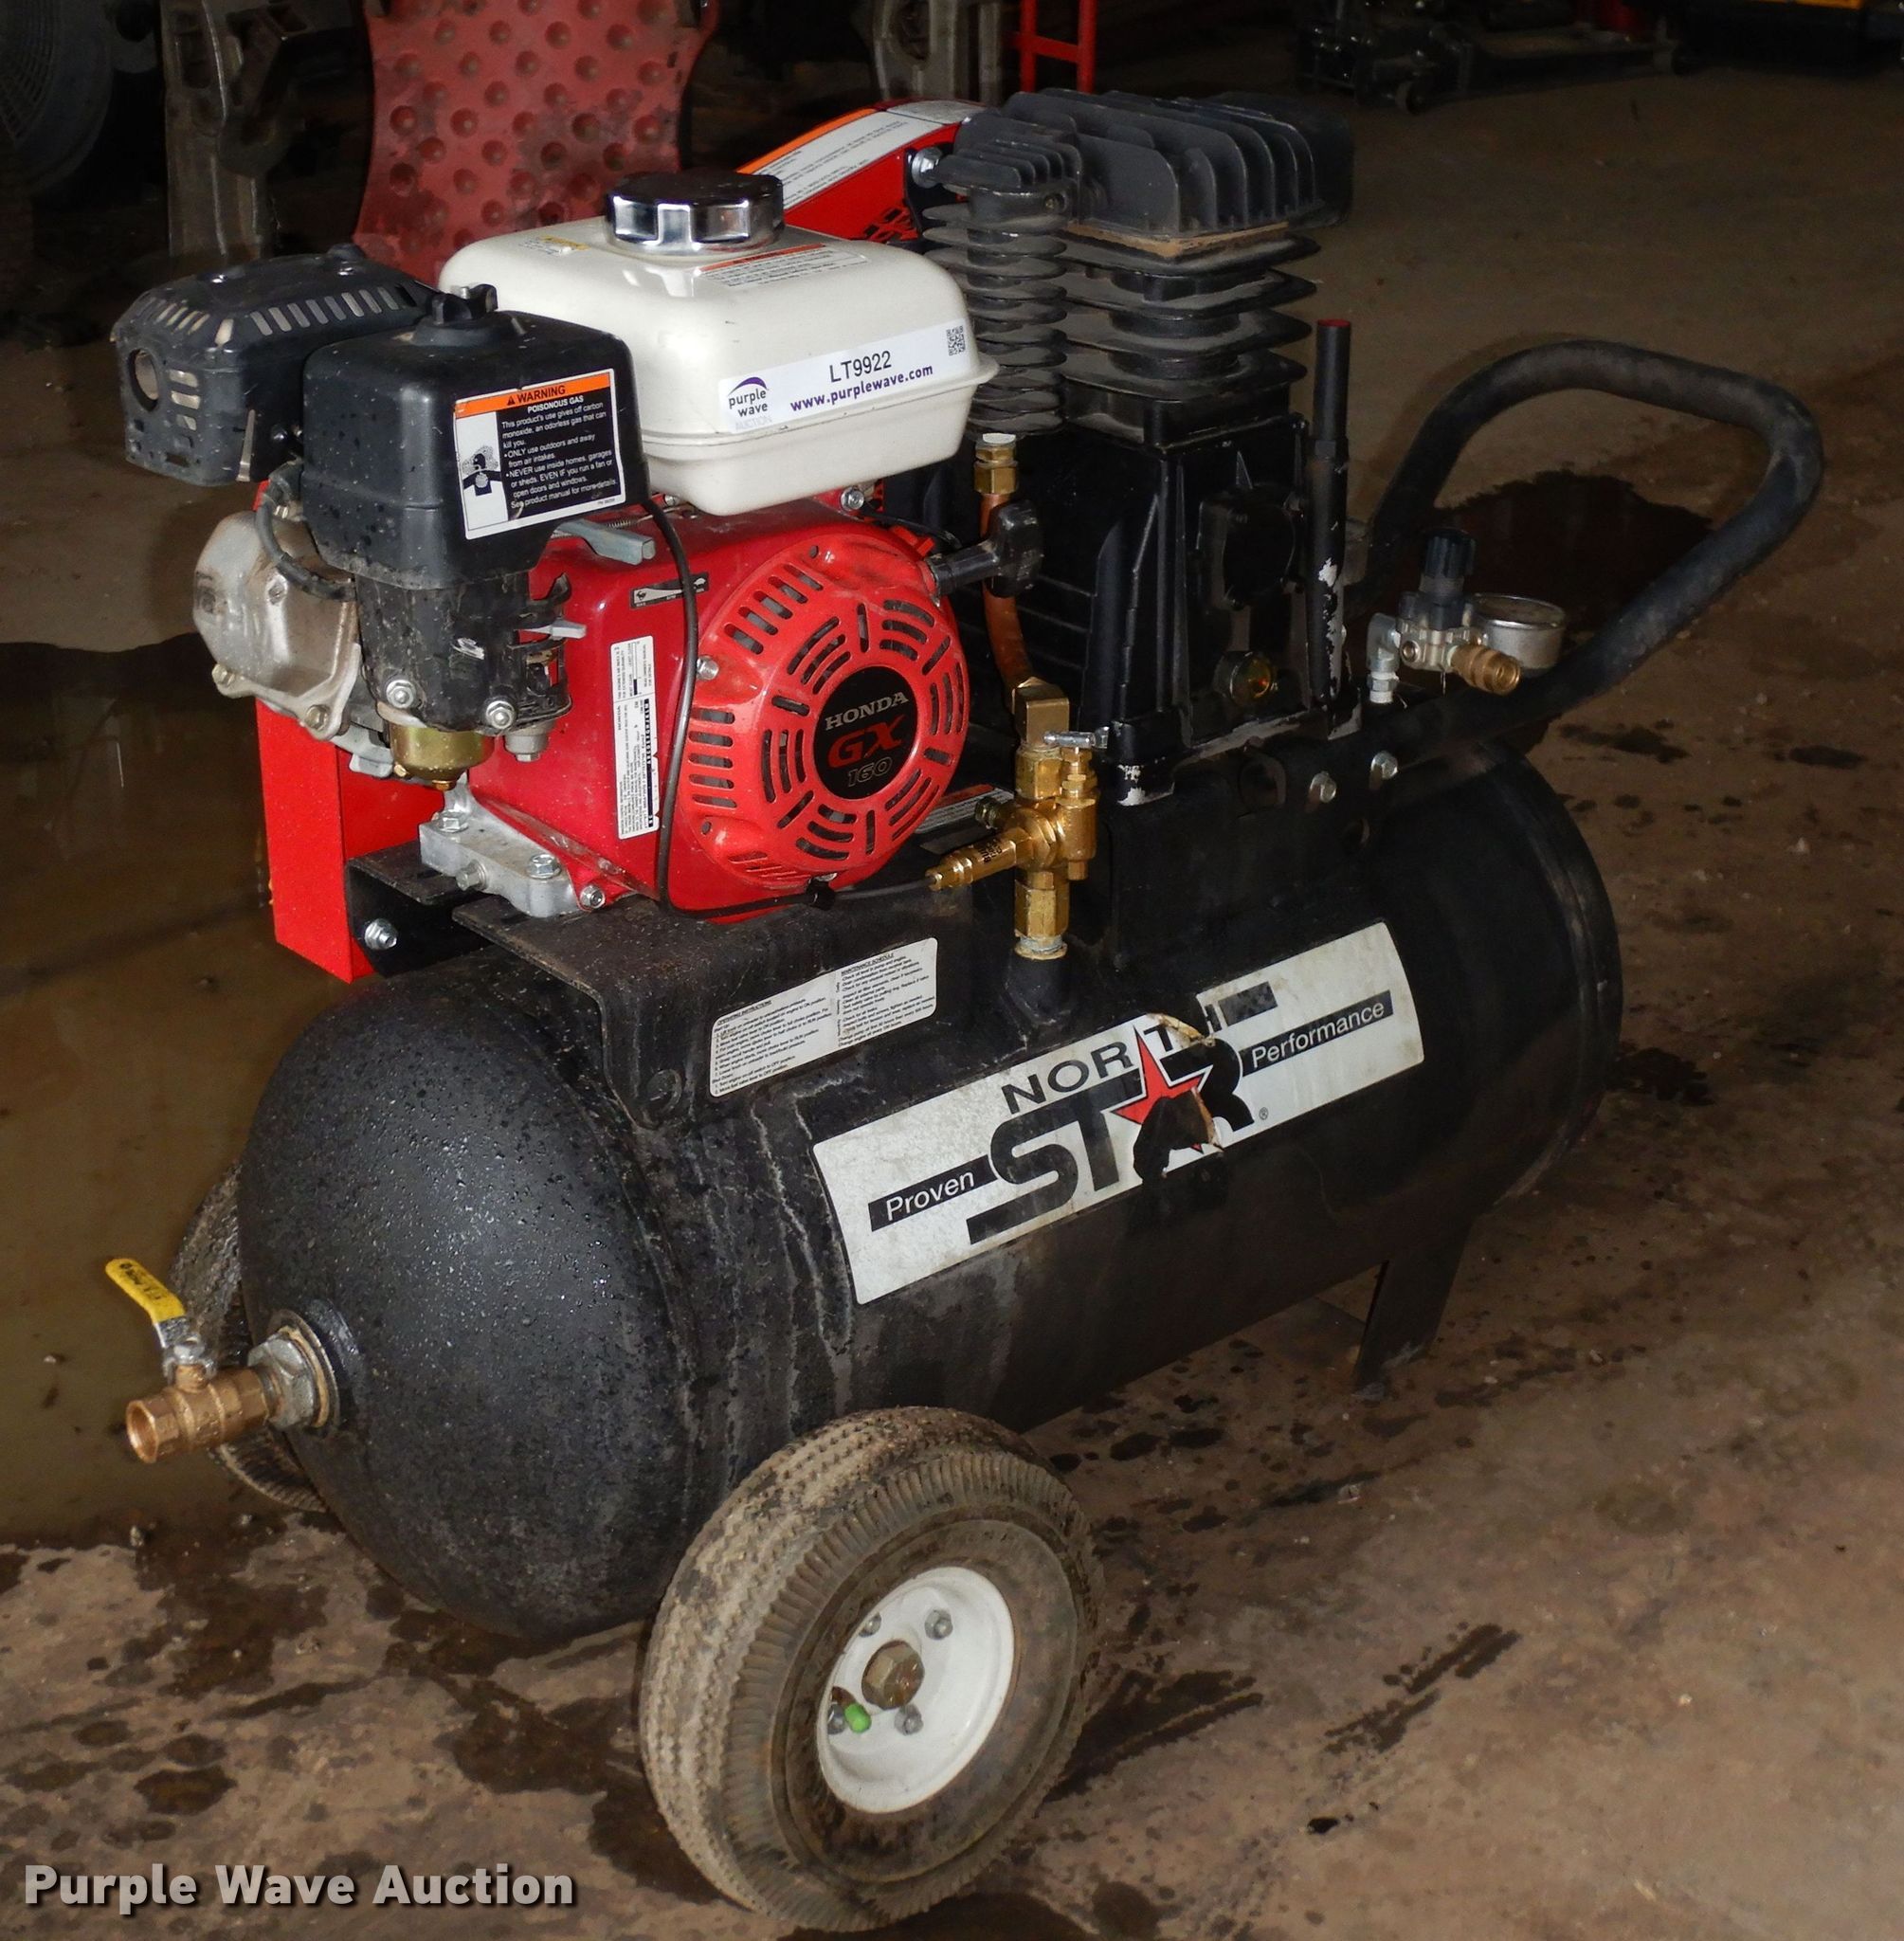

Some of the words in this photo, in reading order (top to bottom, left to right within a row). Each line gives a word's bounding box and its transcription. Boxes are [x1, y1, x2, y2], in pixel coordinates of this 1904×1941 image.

[829, 350, 892, 383] LT9922
[517, 386, 565, 403] WARNING
[729, 388, 767, 409] purple
[789, 364, 934, 412] www.purplewave.com
[501, 419, 515, 429] This
[557, 408, 572, 419] gives
[573, 405, 582, 413] off
[582, 400, 603, 411] carbon
[527, 400, 568, 413] POISONOUS
[569, 394, 584, 405] GAS
[737, 403, 768, 417] wave
[544, 418, 569, 430] odorless
[571, 416, 582, 426] gas
[583, 412, 594, 422] that
[507, 446, 526, 458] ONLY
[539, 440, 565, 450] outdoors
[567, 436, 578, 444] and
[579, 433, 595, 443] away
[508, 458, 522, 467] from
[523, 456, 532, 464] air
[509, 466, 533, 478] NEVER
[546, 459, 564, 469] inside
[539, 469, 558, 481] EVEN
[559, 468, 565, 477] IF
[566, 466, 578, 477] you
[595, 459, 605, 468] fan
[513, 489, 529, 499] open
[529, 483, 547, 494] doors
[548, 481, 559, 489] and
[524, 495, 547, 507] product
[548, 489, 570, 499] manual
[824, 691, 910, 731] HONDA
[827, 714, 907, 769] GX
[847, 756, 894, 788] 160
[1251, 999, 1386, 1068] Performance
[885, 1170, 974, 1222] Proven
